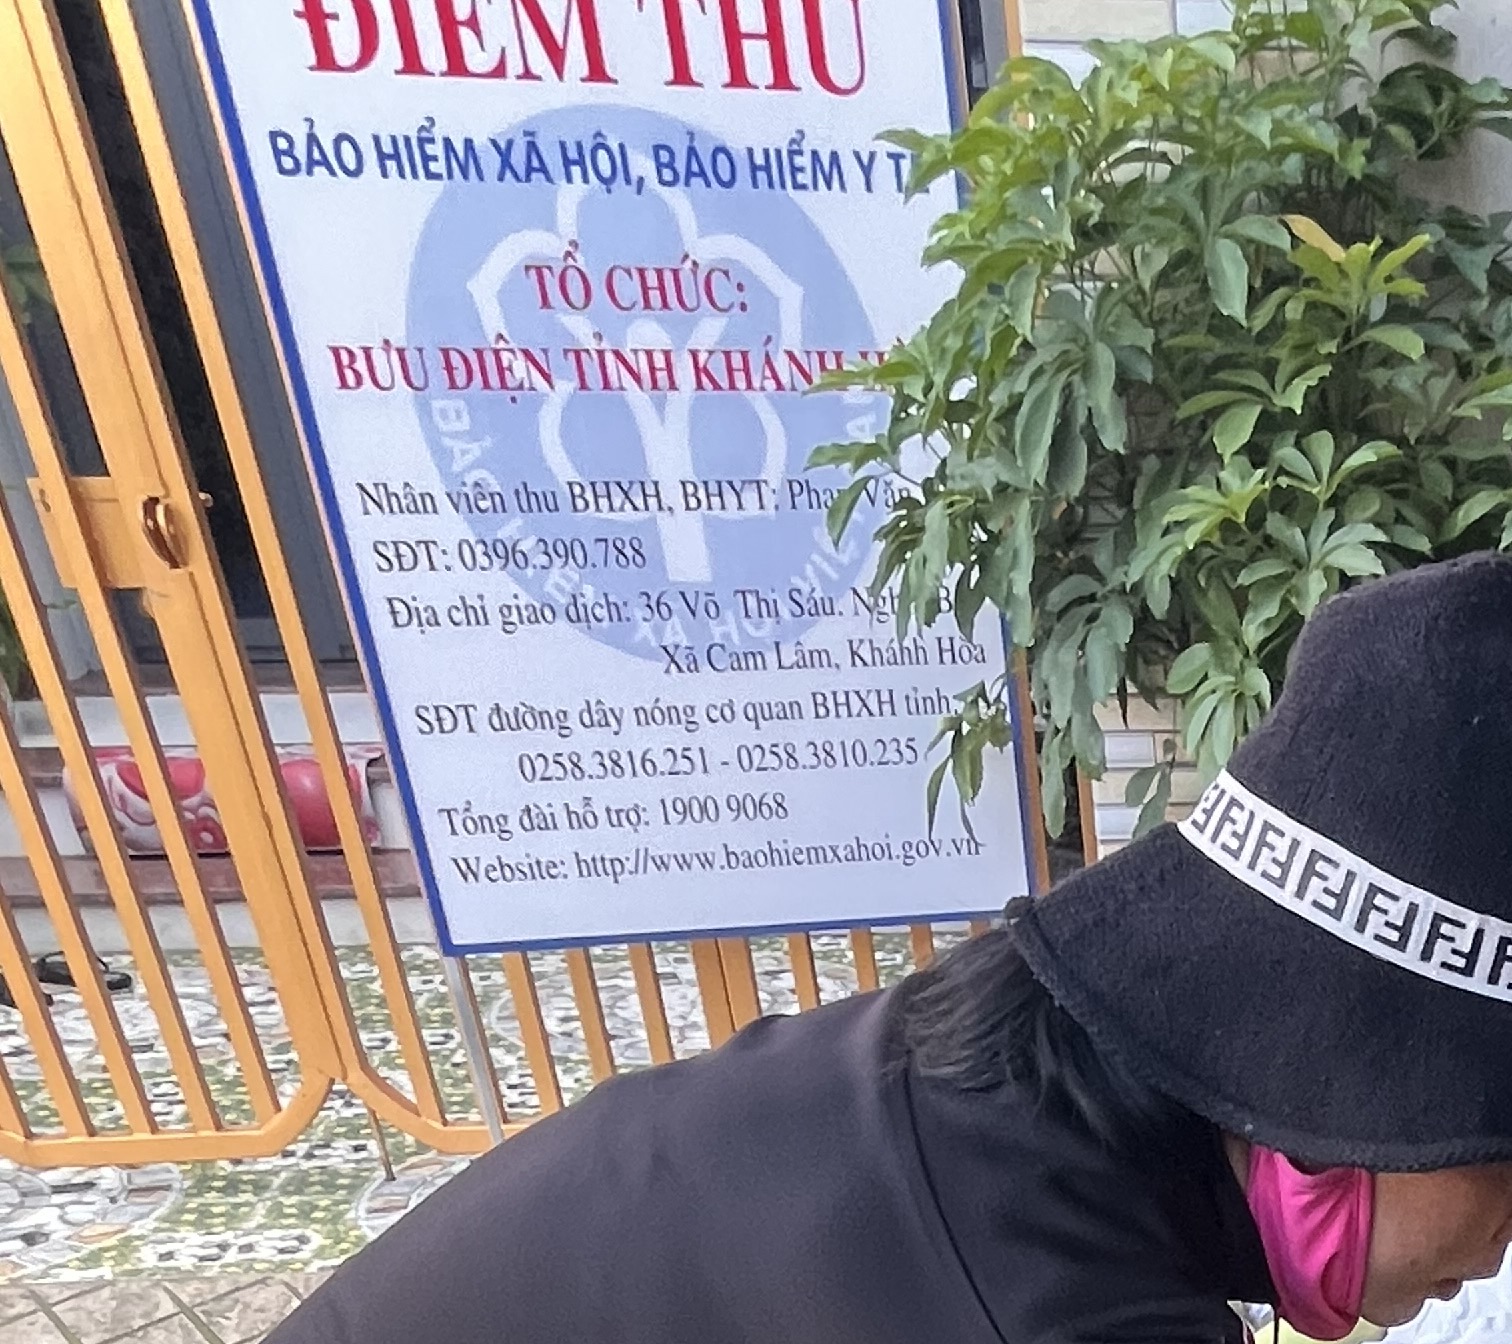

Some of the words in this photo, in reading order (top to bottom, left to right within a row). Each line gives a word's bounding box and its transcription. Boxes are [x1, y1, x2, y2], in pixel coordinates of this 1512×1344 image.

[269, 117, 364, 179] BẢO
[372, 116, 485, 182] HIỂM
[489, 129, 555, 184] XÃ
[559, 132, 644, 196] HỘI,
[652, 129, 737, 190] BẢO
[746, 128, 847, 193] HIỂM
[853, 150, 878, 193] Y
[524, 238, 593, 311] TỔ
[605, 252, 748, 313] CHỨC:
[327, 338, 429, 392] BƯU
[438, 333, 555, 404] ĐIỆN
[563, 331, 679, 391] TỈNH
[356, 481, 439, 516] Nhân
[446, 480, 507, 514] viên
[514, 481, 560, 514] thu
[566, 480, 674, 515] BHXH,
[680, 479, 780, 513] BHYT:
[373, 539, 452, 573] SĐT:
[458, 537, 647, 572] 0396.390.788
[386, 595, 442, 635] Địa
[447, 593, 490, 627] chỉ
[499, 593, 556, 635] giao
[565, 592, 632, 630] dịch:
[640, 590, 672, 623] 36
[679, 590, 720, 620] Võ
[733, 588, 780, 626] Thị
[661, 644, 701, 675] Xã
[706, 643, 768, 673] Cam
[775, 641, 840, 673] Lâm,
[847, 637, 929, 668] Khánh
[936, 636, 986, 666] Hòa
[415, 704, 478, 735] SĐT
[488, 702, 573, 738] đường
[579, 699, 624, 736] dây
[634, 697, 700, 733] nóng
[705, 699, 736, 725] cơ
[743, 699, 804, 730] quan
[811, 688, 897, 719] BHXH
[518, 746, 710, 783] 0258.3816.251
[736, 737, 918, 773] 0258.3810.235
[437, 800, 514, 841] Tổng
[518, 802, 559, 832] đài
[563, 796, 599, 831] hỗ
[605, 803, 650, 833] trợ:
[659, 795, 720, 826] 1900
[726, 792, 789, 823] 9068
[450, 852, 568, 883] Website:
